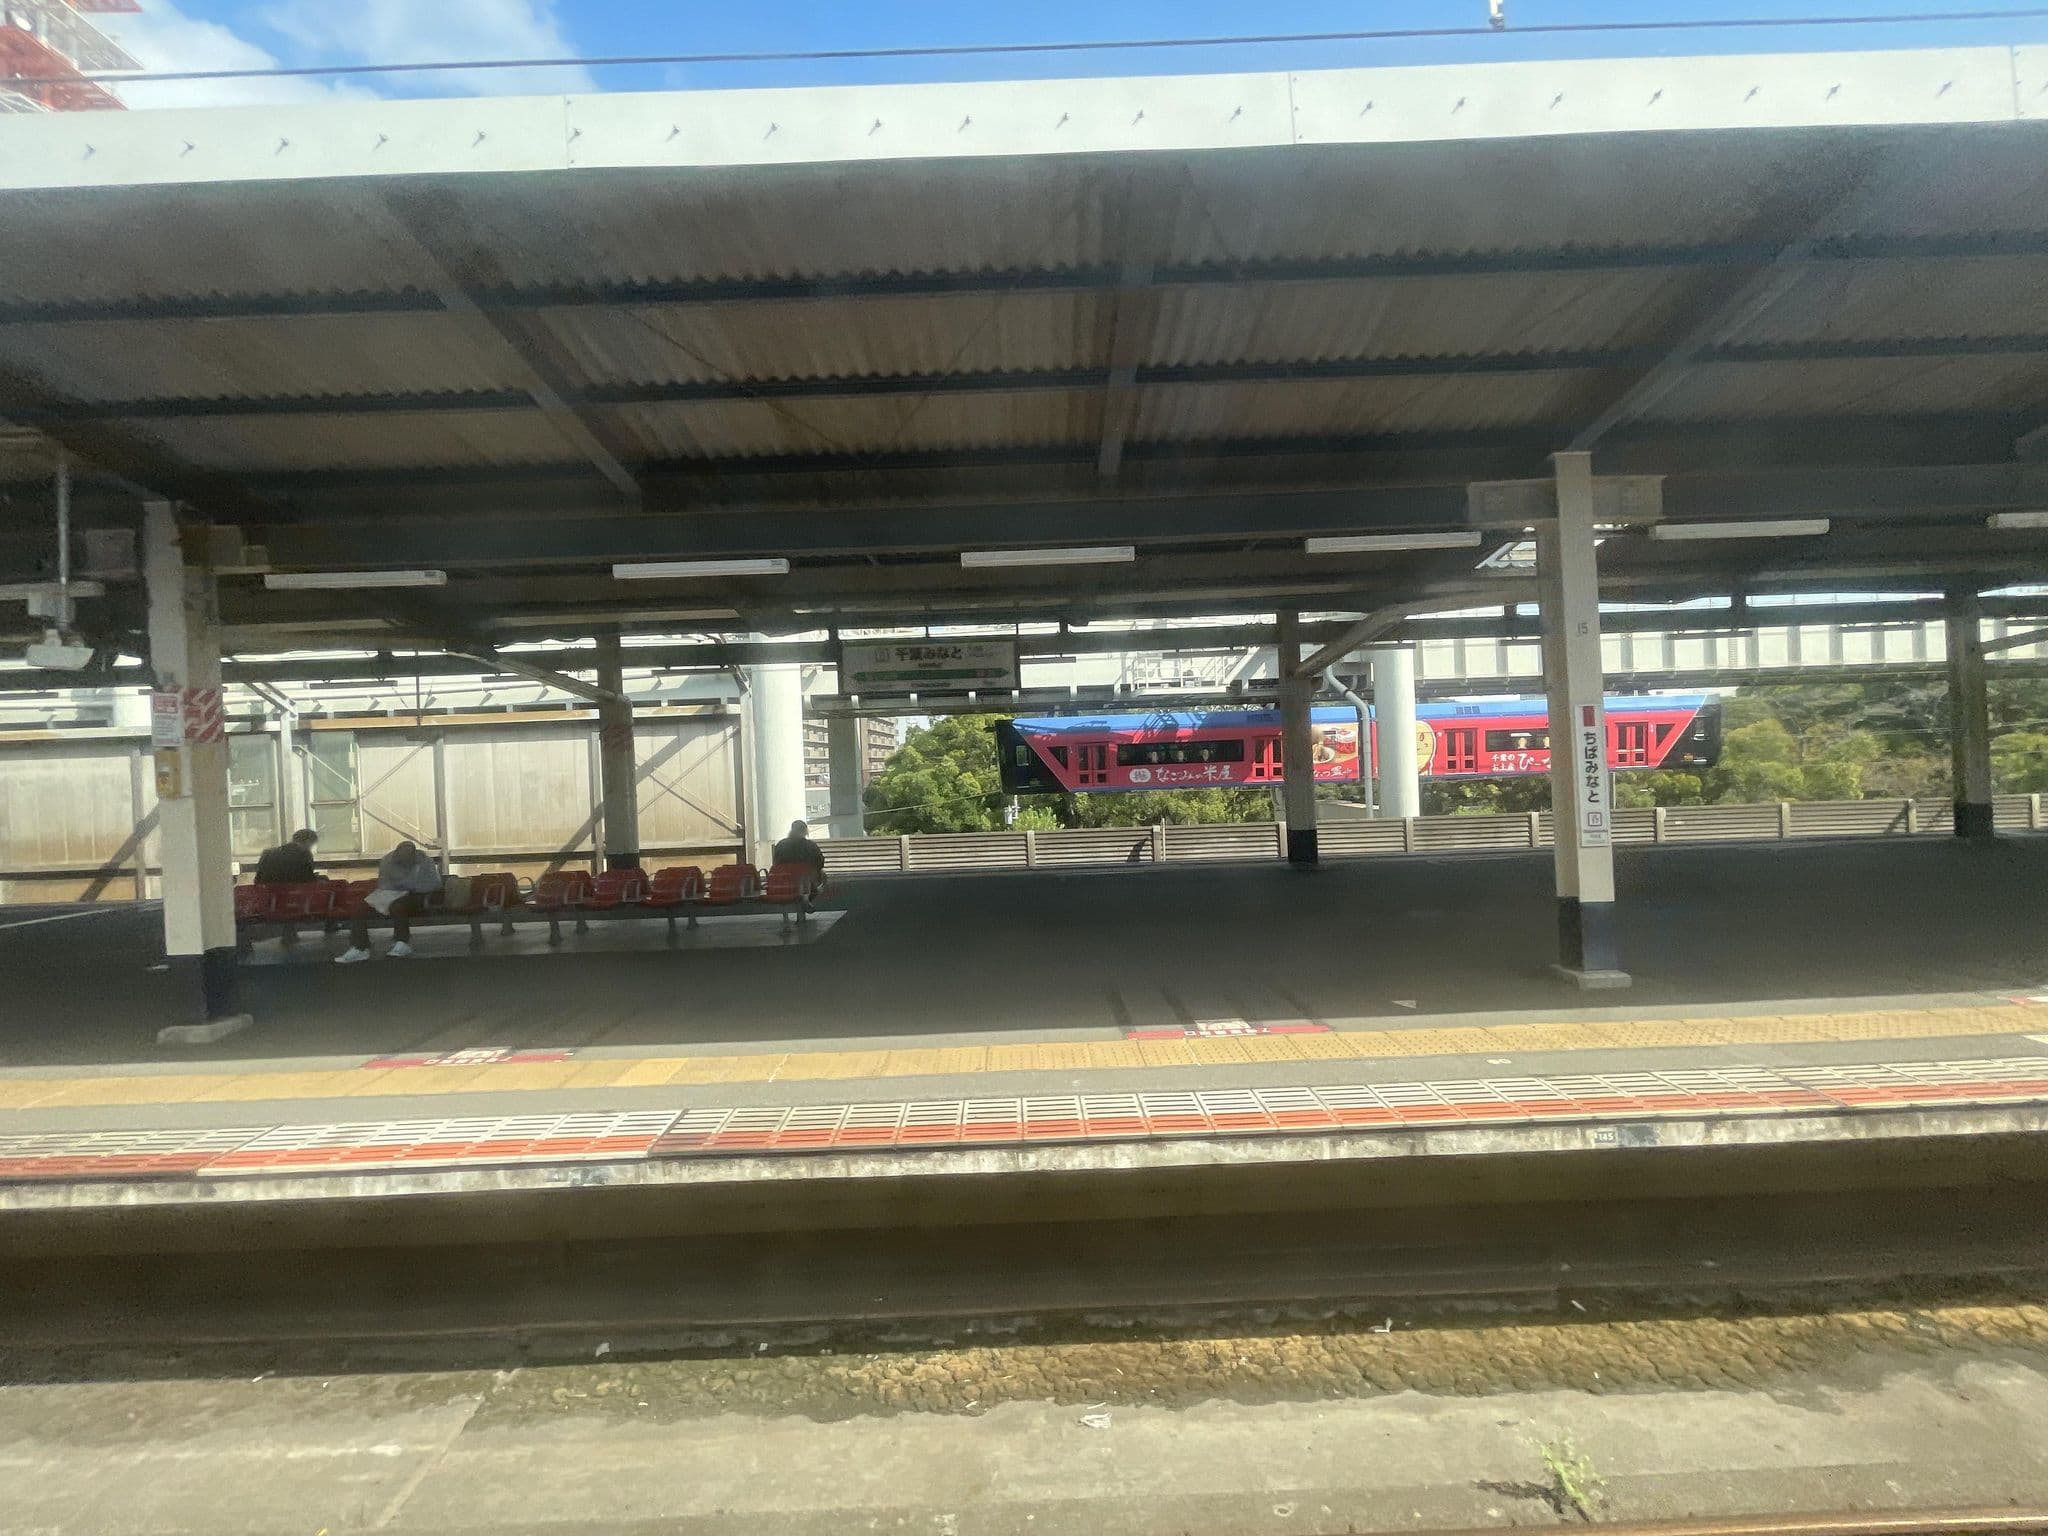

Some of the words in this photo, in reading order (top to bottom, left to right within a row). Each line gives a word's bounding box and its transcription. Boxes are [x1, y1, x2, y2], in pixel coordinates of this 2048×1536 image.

[1577, 622, 1589, 634] 15
[1583, 731, 1600, 803] ちばみなと
